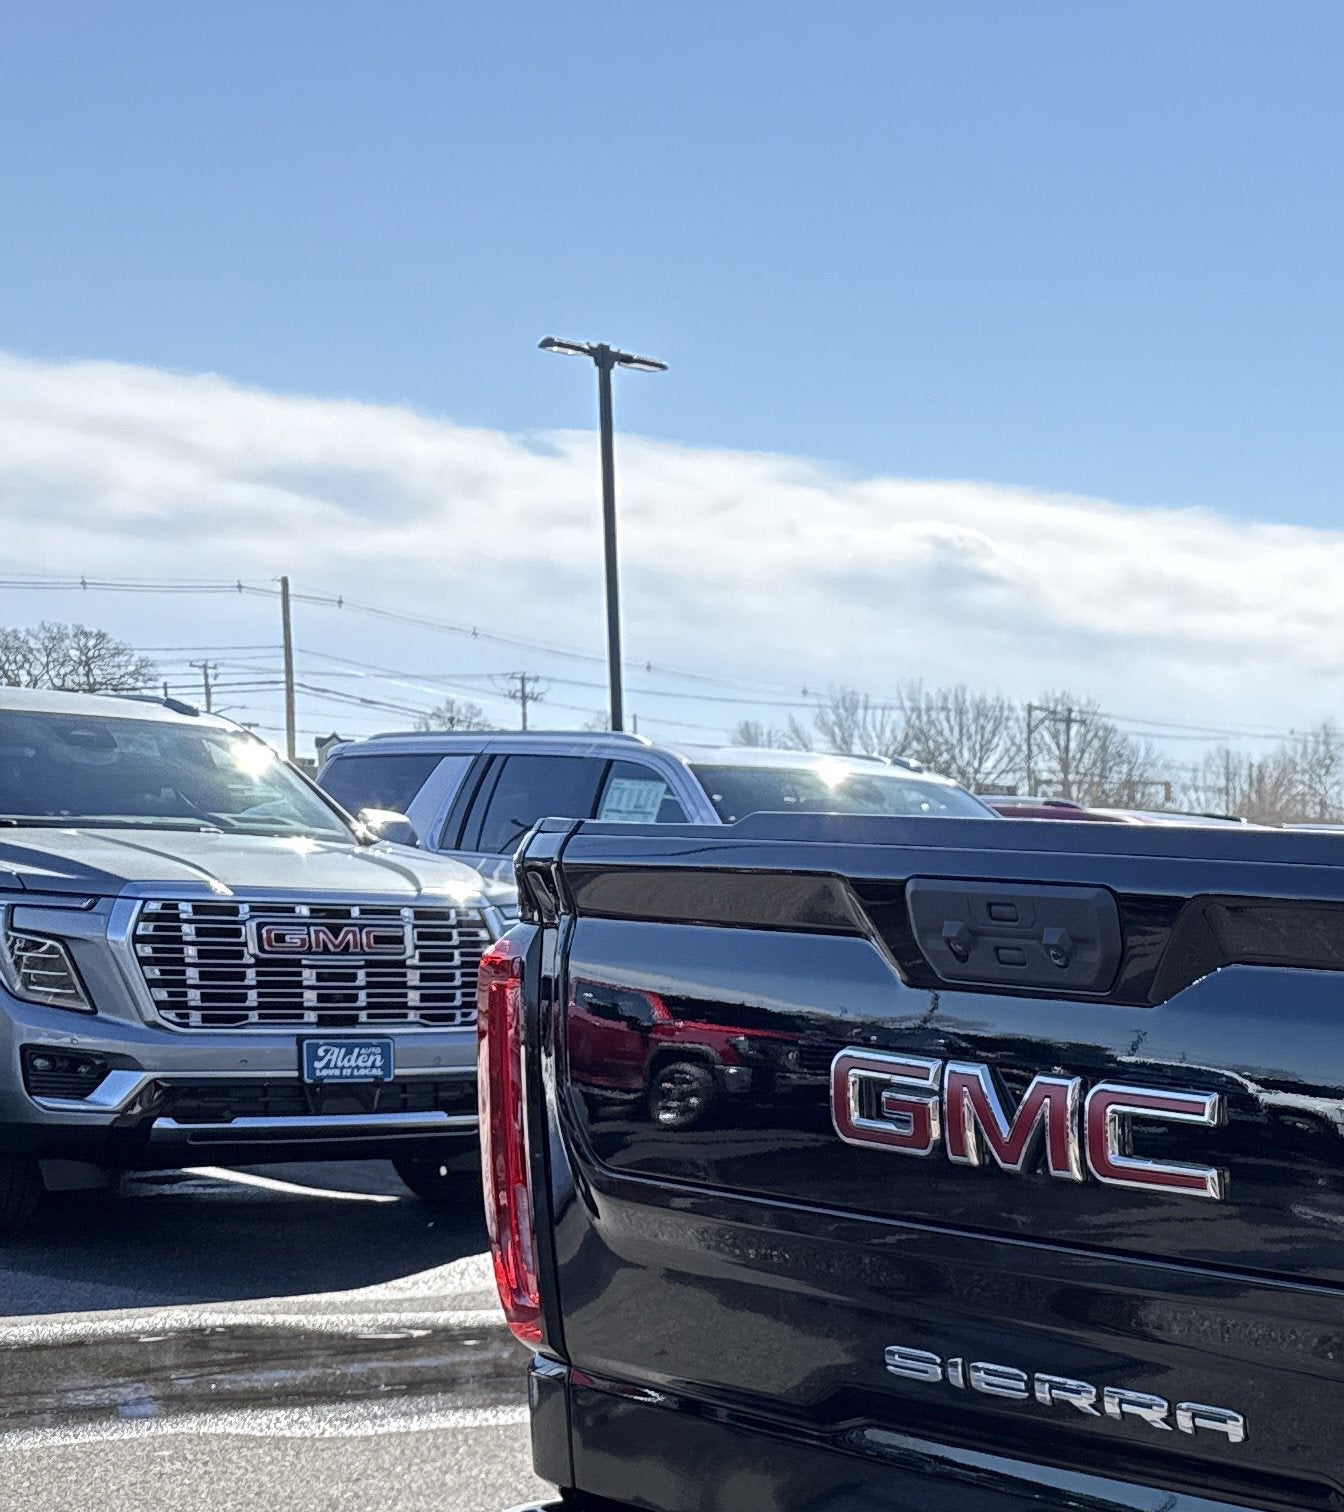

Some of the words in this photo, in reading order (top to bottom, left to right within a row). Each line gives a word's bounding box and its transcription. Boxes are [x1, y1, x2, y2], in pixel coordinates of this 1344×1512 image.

[262, 925, 405, 953] GMC
[313, 1045, 385, 1068] Alden
[830, 1045, 1229, 1201] GMC
[884, 1345, 1249, 1444] SIERRA
